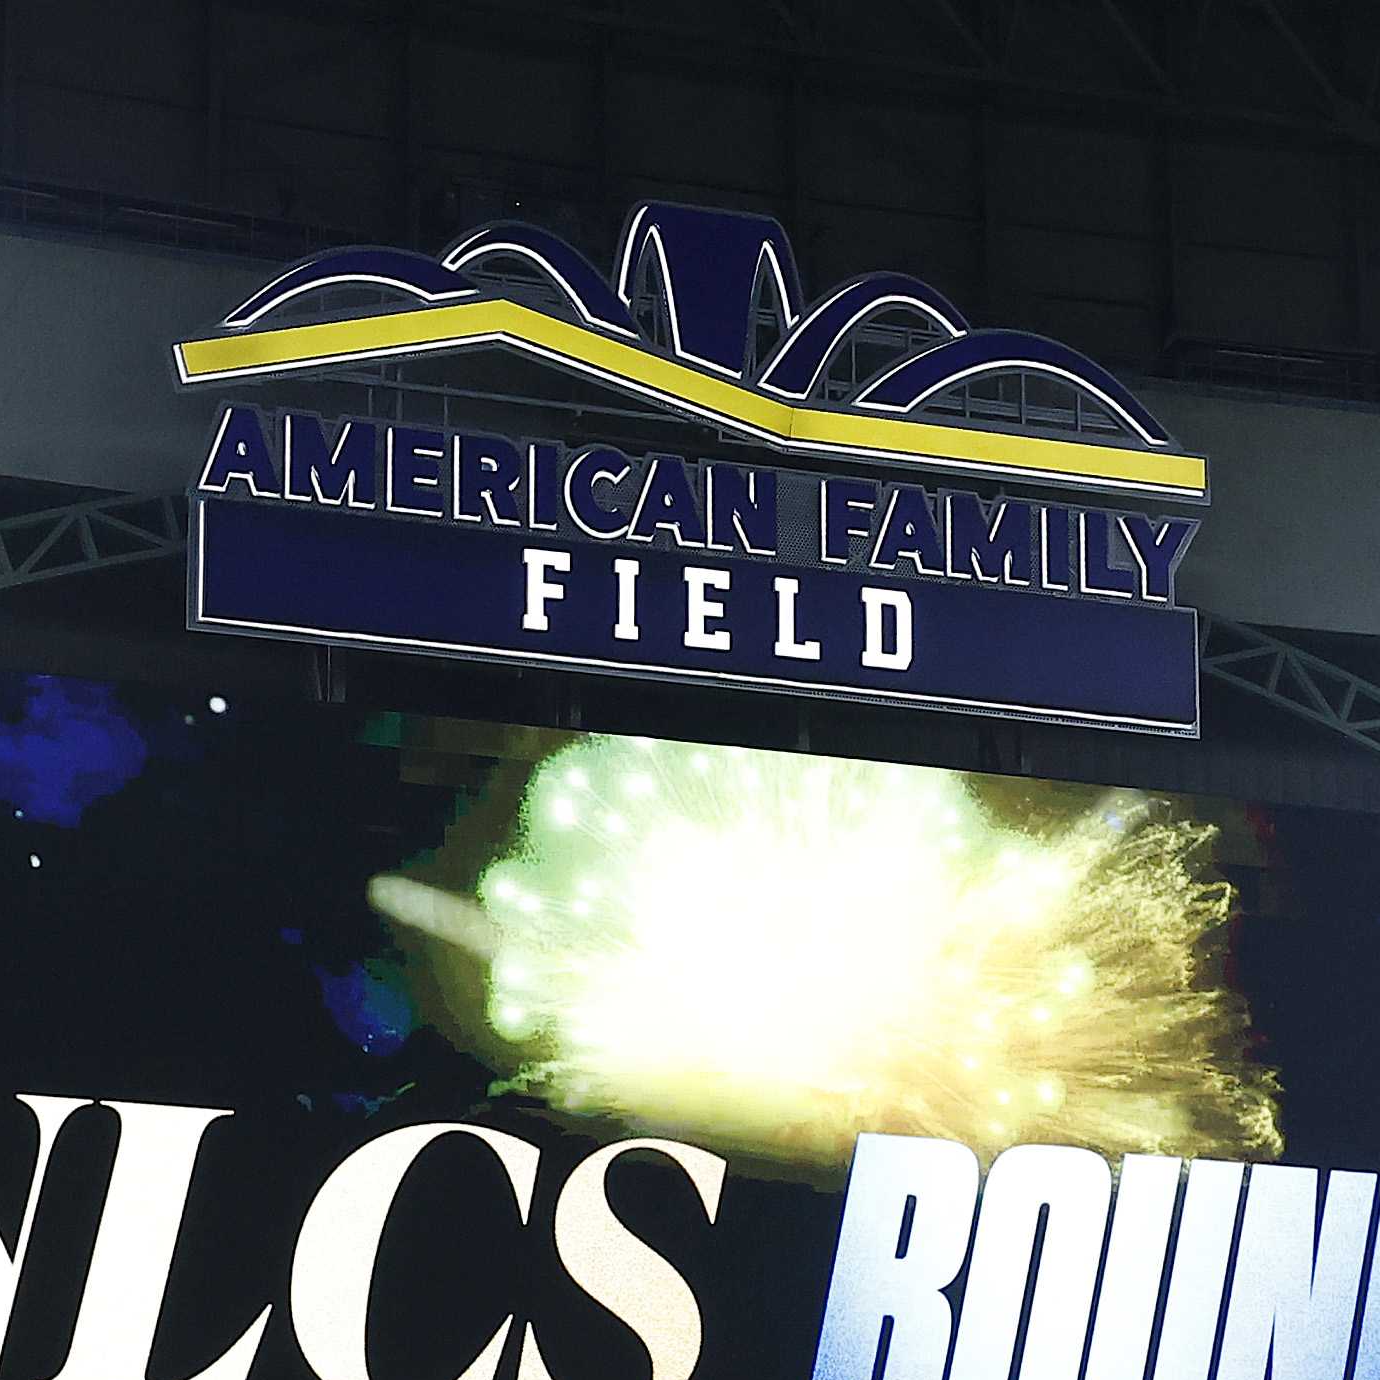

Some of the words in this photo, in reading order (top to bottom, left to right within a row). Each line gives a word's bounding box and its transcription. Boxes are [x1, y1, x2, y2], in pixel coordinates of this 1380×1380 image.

[198, 407, 777, 557] AMERICAN
[818, 478, 1197, 604] FAMILY
[521, 547, 914, 671] FIELD
